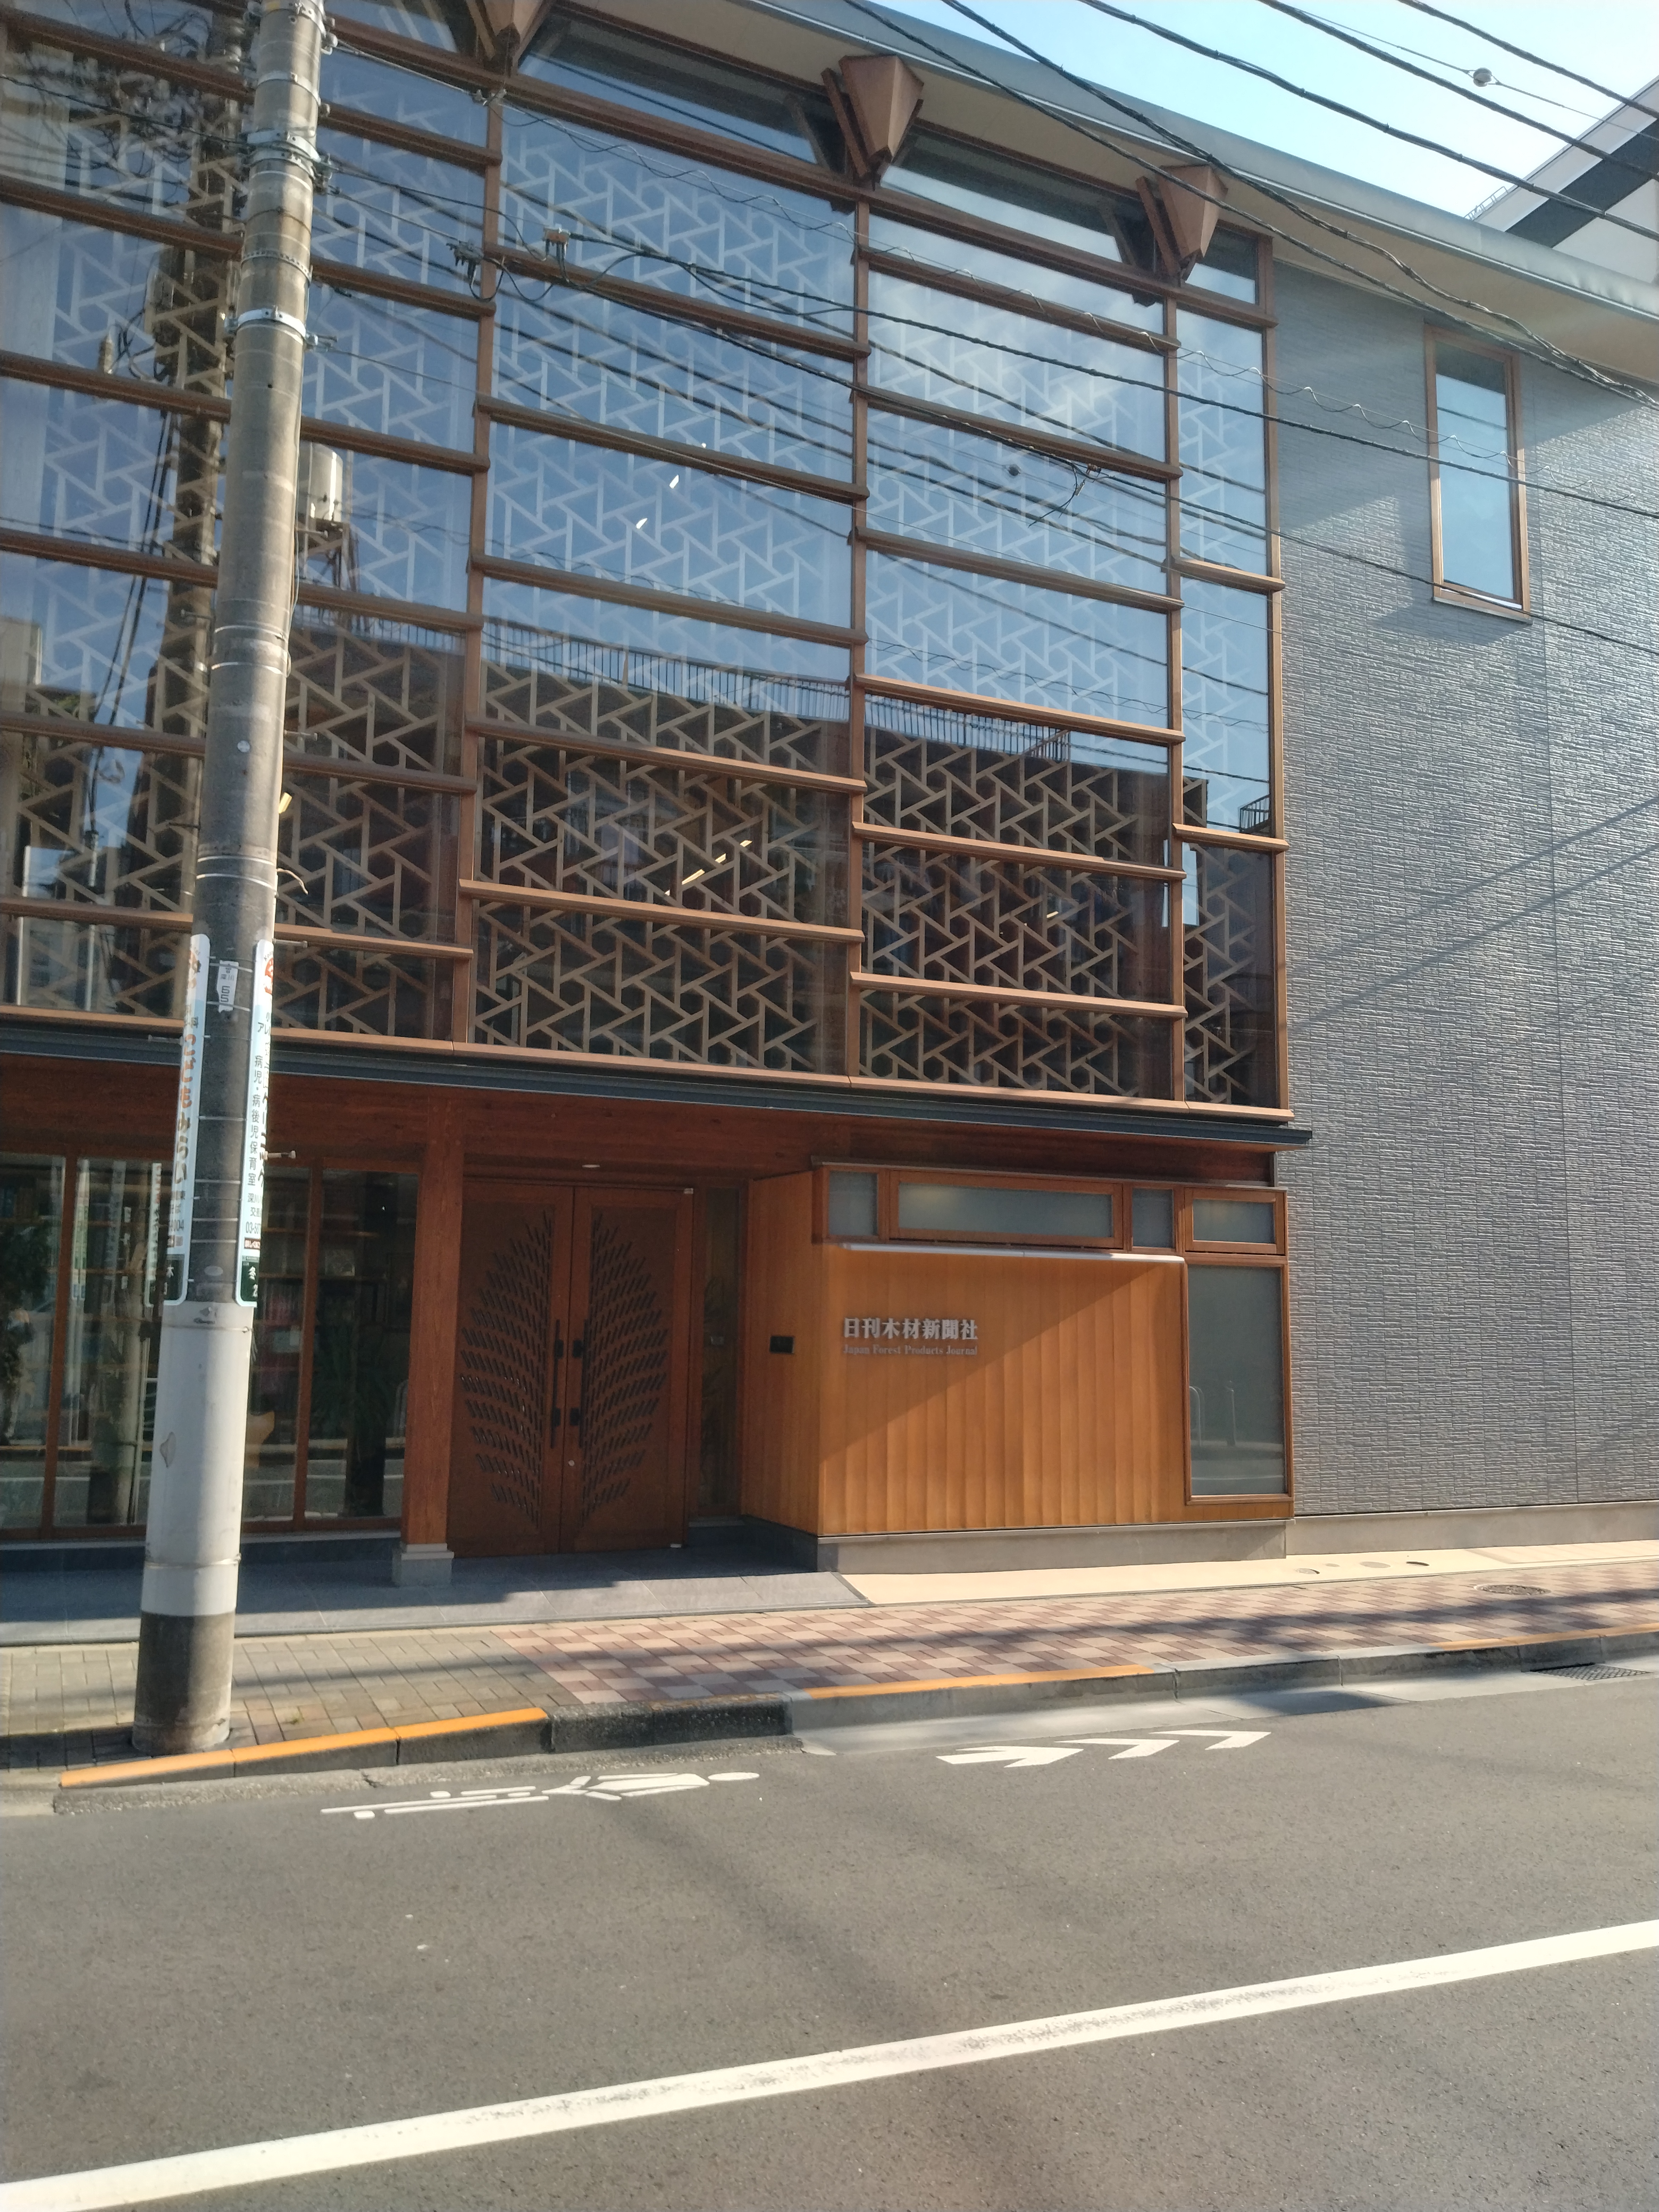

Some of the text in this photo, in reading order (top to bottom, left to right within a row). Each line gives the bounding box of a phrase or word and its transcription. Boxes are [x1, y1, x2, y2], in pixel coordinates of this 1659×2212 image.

[248, 1055, 263, 1186] 病児・病後児保育室
[843, 1318, 978, 1340] 日刊木材新聞社
[843, 1344, 978, 1356] Japan Forest Products Journal
